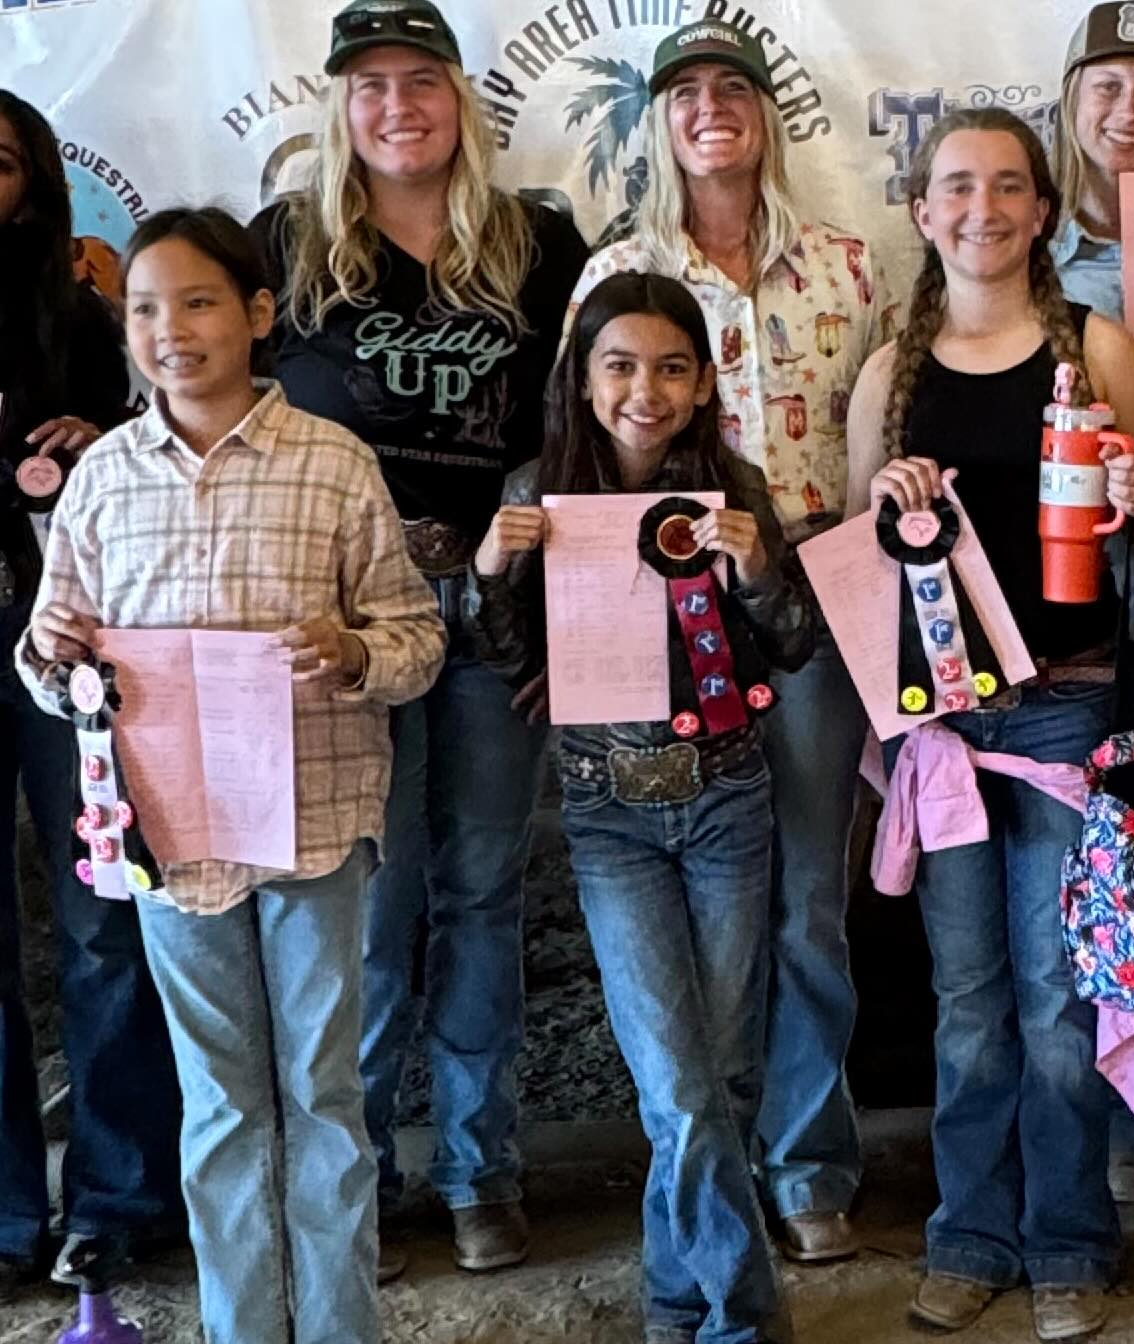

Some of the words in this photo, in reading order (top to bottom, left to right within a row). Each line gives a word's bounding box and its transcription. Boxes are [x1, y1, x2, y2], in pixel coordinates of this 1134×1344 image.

[221, 73, 330, 139] BIAN
[57, 138, 149, 225] QUESTRI
[355, 311, 518, 375] Giddy
